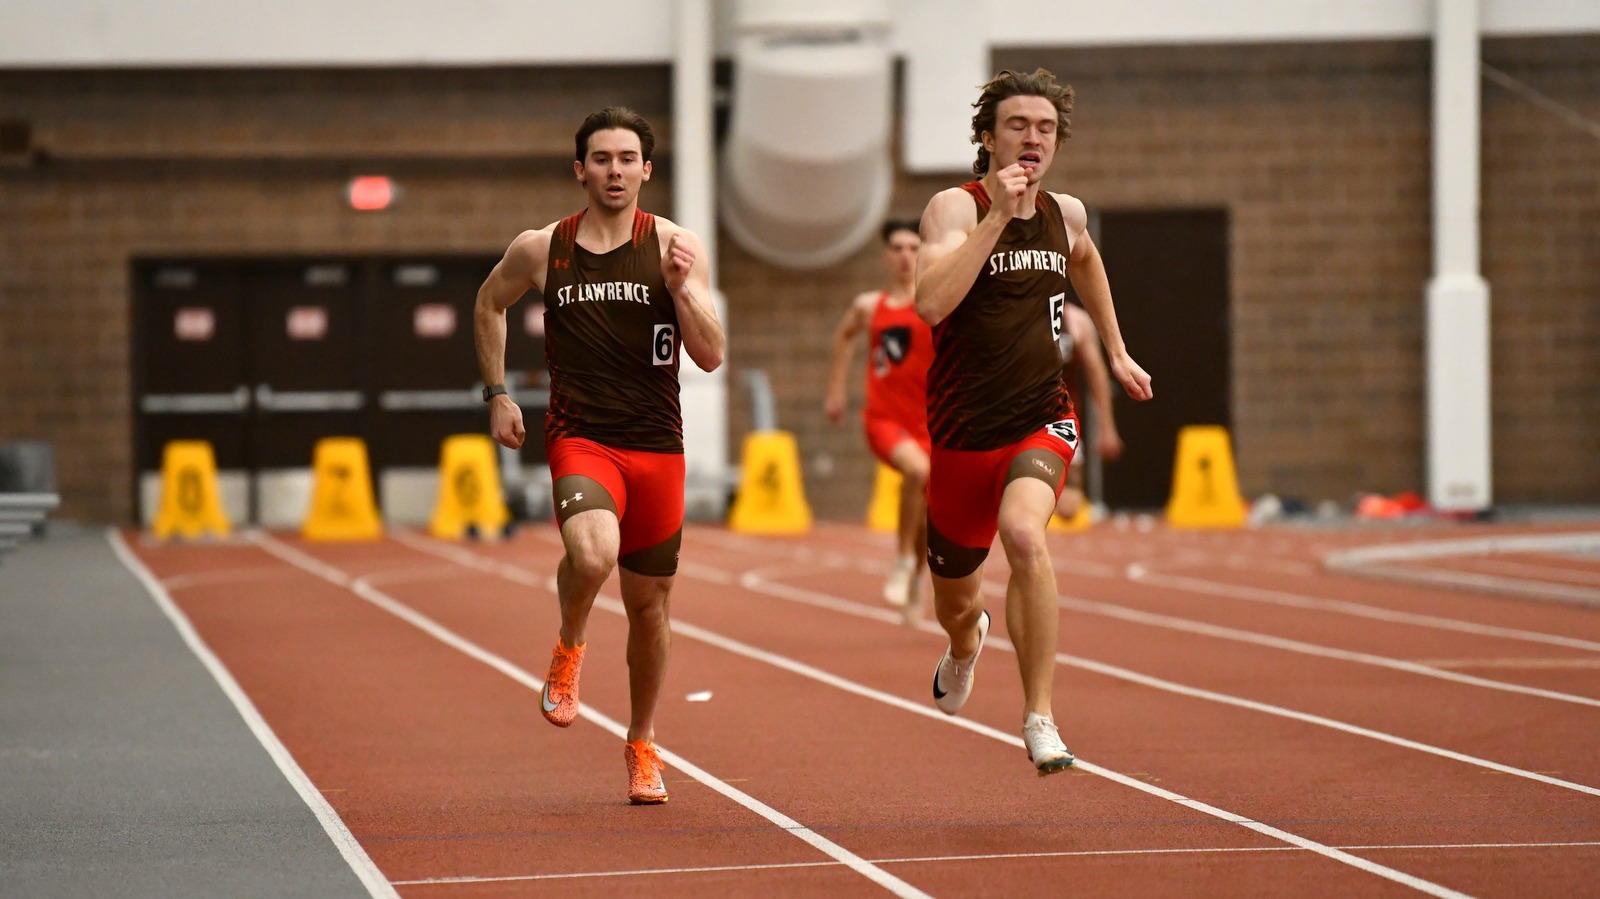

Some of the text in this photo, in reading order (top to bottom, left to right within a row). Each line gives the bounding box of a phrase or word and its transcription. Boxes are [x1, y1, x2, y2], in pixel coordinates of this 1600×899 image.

[990, 250, 1066, 278] ST. LAWRENCE
[557, 281, 651, 307] ST. LAWRENCE
[1053, 297, 1064, 336] 5
[655, 327, 673, 361] 6
